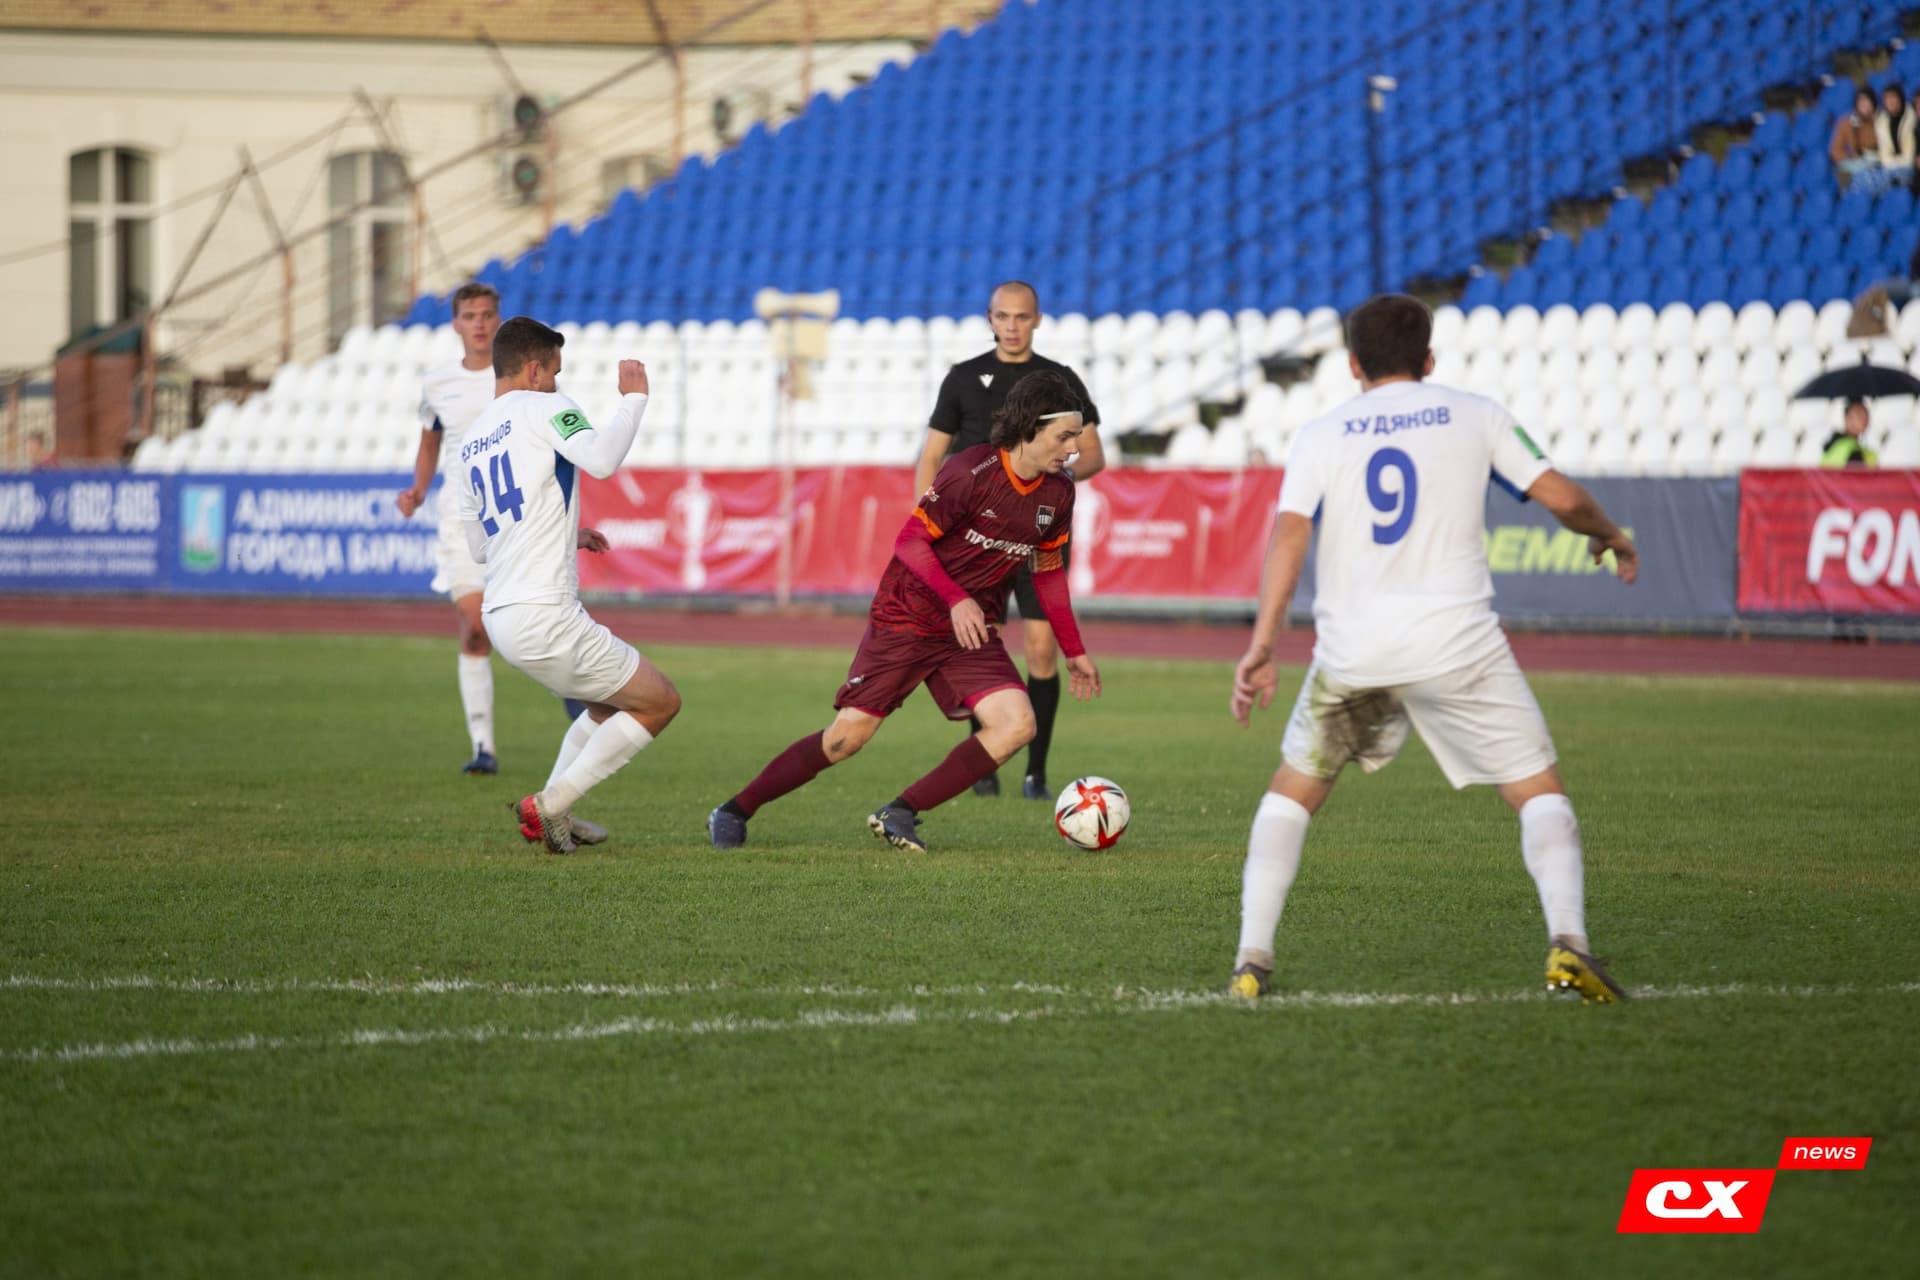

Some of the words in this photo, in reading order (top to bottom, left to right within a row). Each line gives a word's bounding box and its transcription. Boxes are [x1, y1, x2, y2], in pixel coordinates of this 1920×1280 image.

[470, 449, 525, 538] 24
[1366, 446, 1418, 545] 9
[226, 533, 345, 580] ГОРОДА
[1484, 526, 1634, 575] EMI
